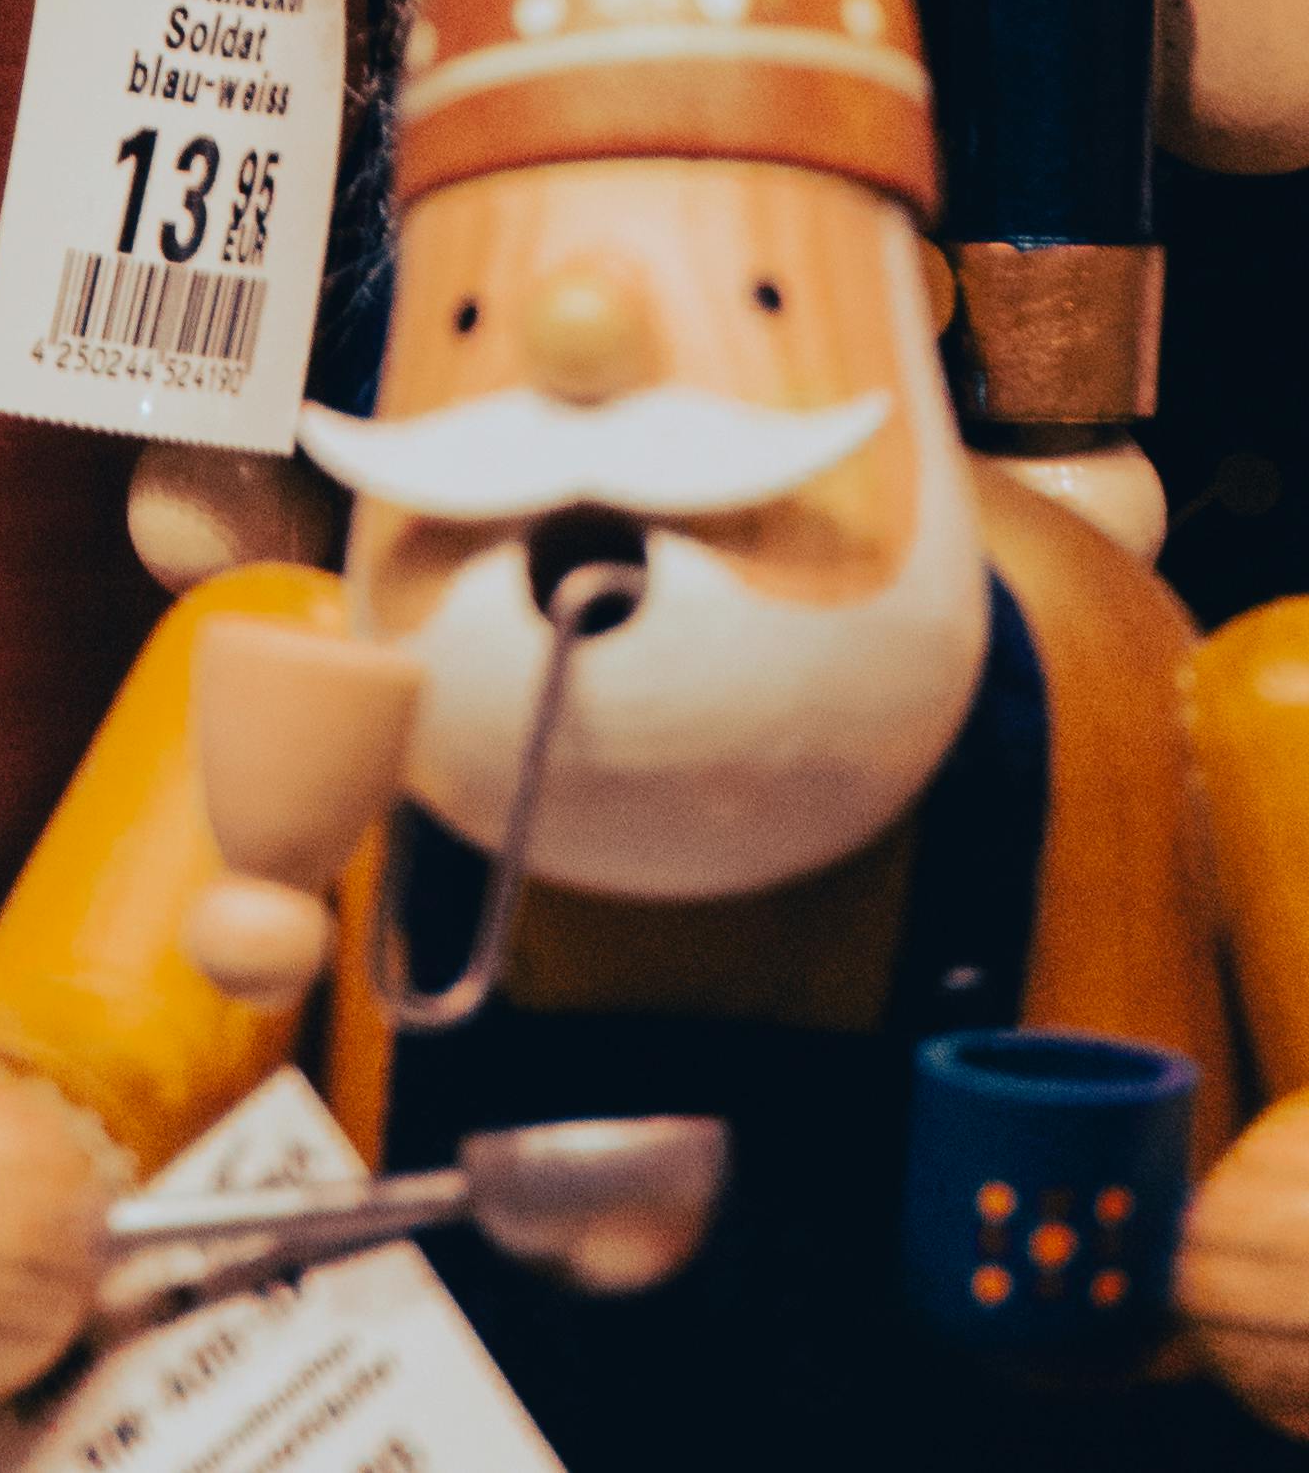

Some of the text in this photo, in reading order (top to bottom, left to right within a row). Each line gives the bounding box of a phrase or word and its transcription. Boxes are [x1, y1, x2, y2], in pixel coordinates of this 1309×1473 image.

[165, 5, 267, 62] Soldat
[127, 49, 290, 116] blau-weiss
[116, 126, 279, 264] 13 95
[222, 221, 267, 269] EUR
